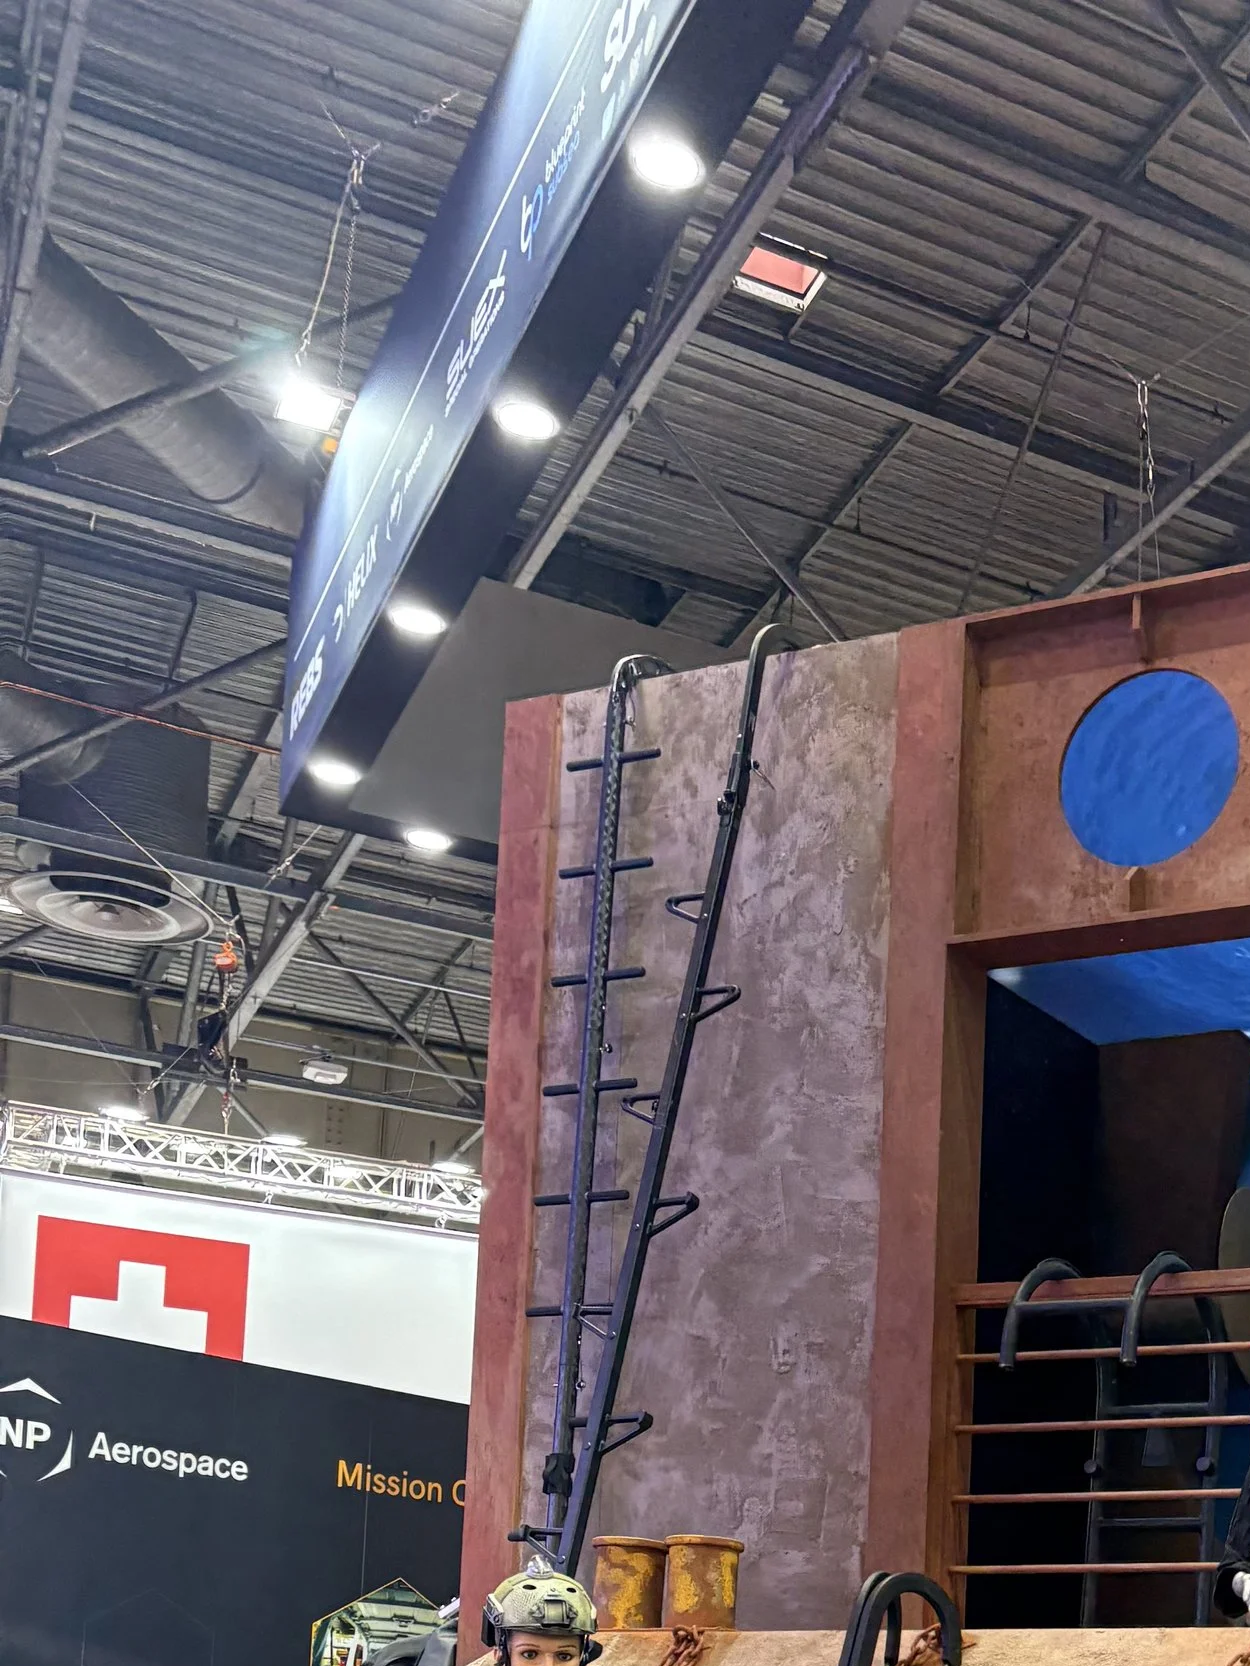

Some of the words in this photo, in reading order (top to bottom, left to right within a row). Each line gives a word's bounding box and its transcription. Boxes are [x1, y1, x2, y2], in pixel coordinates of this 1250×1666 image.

[289, 634, 325, 741] REBS
[0, 1416, 52, 1450] NP
[88, 1431, 249, 1482] Aerospace
[337, 1459, 443, 1503] Mission
